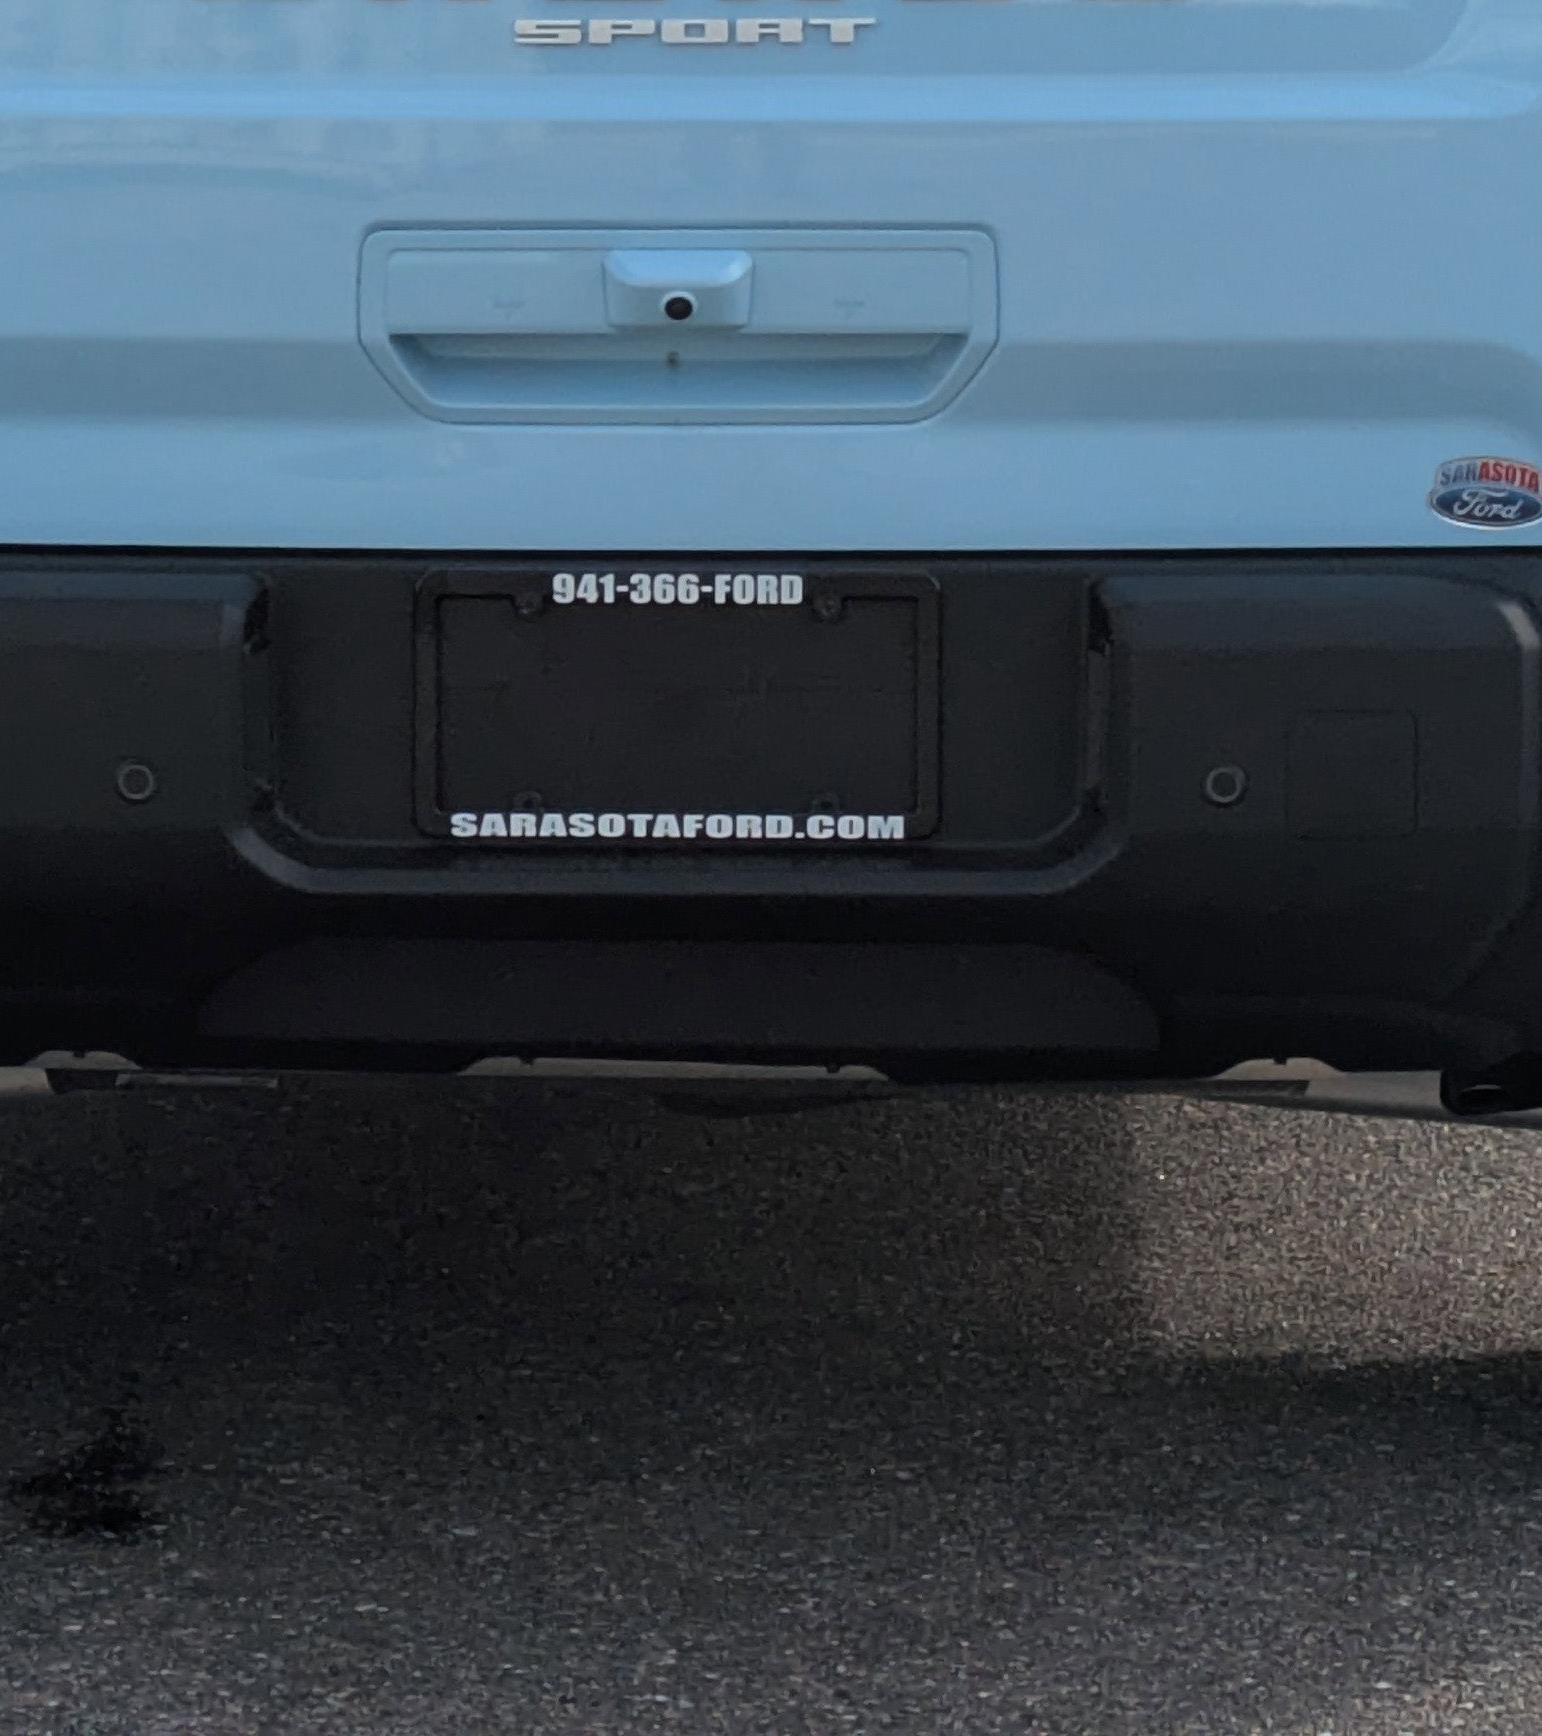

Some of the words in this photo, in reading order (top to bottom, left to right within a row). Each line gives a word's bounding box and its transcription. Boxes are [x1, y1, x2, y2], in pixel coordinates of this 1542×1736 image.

[513, 17, 877, 45] SPORT
[1439, 461, 1540, 493] SARASOTA
[1452, 489, 1525, 520] Ford
[551, 573, 805, 605] 941-366-FORD
[450, 811, 905, 841] SARASOTAFORD.COM
